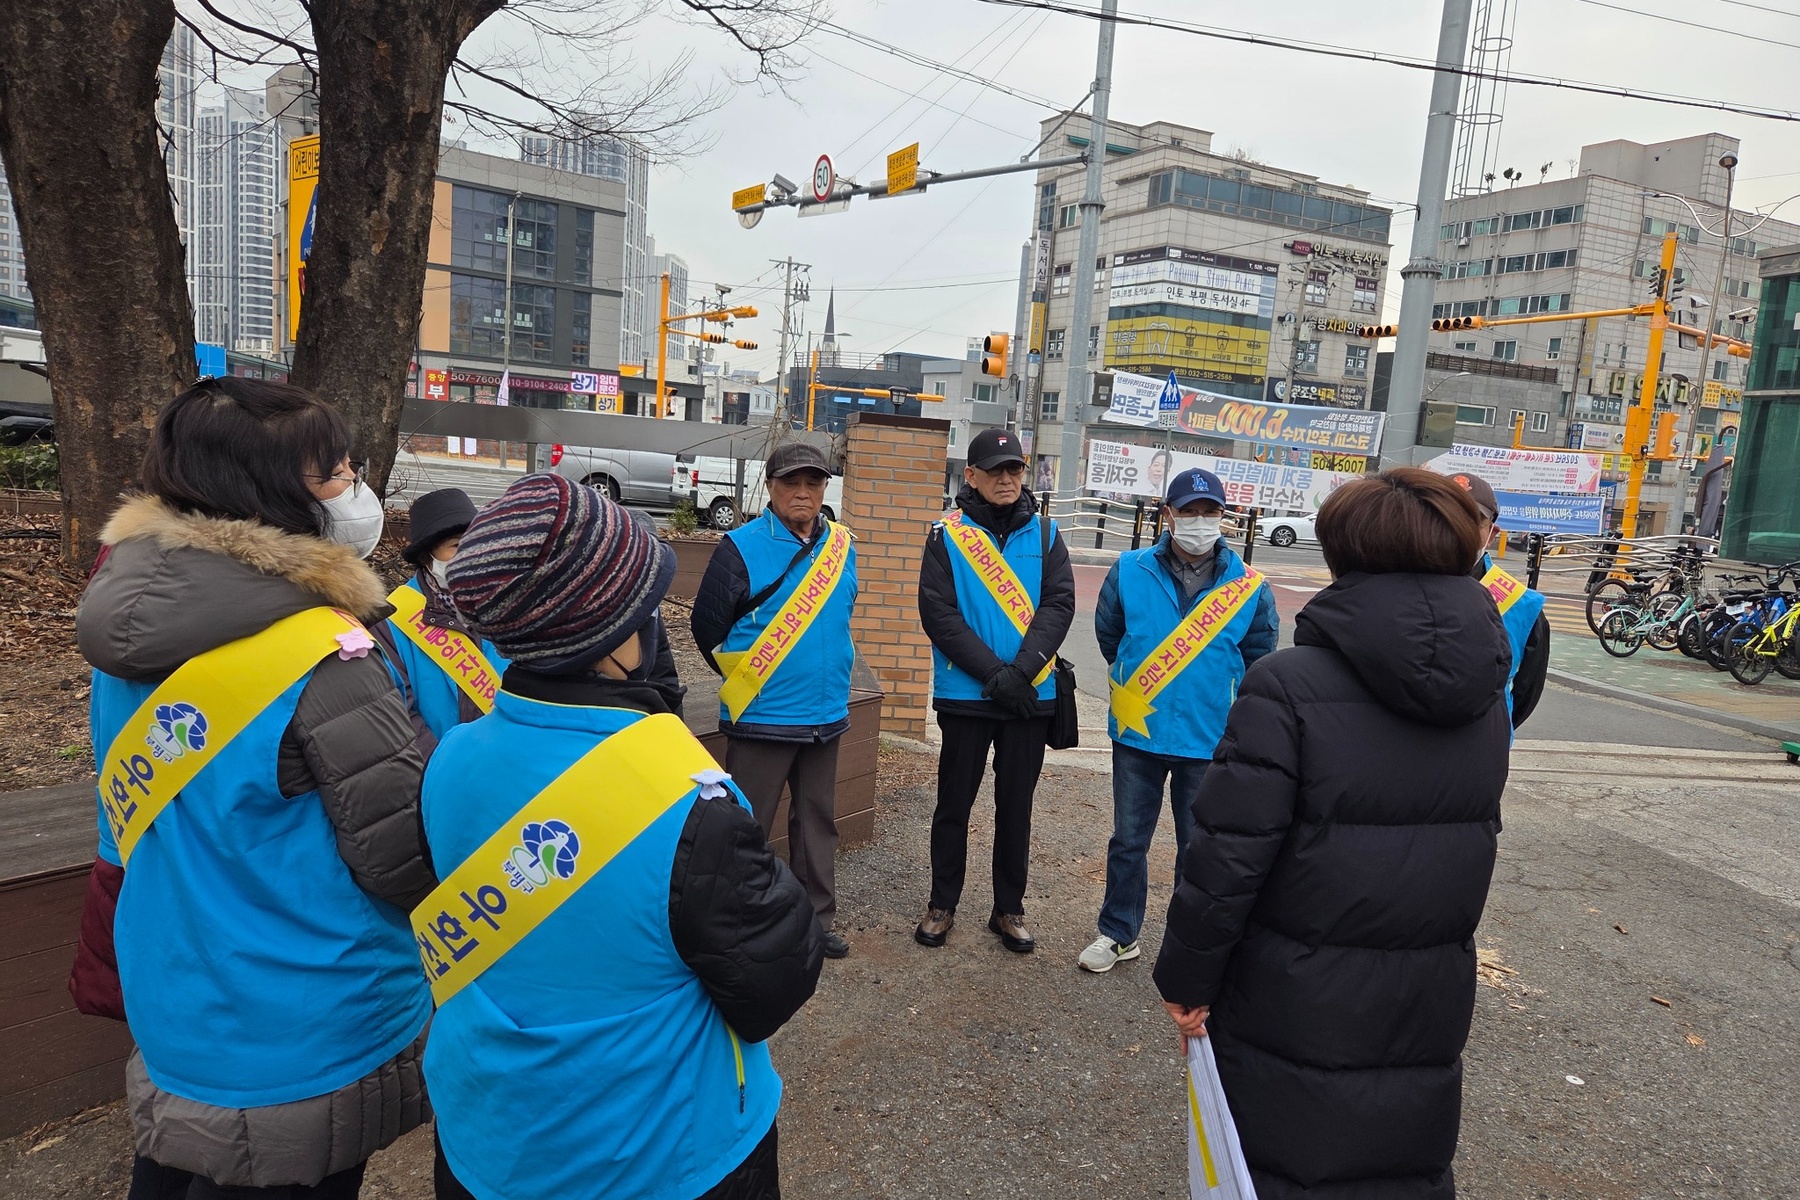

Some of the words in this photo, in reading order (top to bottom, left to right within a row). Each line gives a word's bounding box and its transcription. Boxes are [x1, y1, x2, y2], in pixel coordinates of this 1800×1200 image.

[816, 165, 829, 190] 50
[1037, 239, 1049, 282] 독서실
[1353, 250, 1383, 269] 독서실
[1206, 268, 1229, 289] STUDY
[1235, 273, 1255, 293] PLACE
[1166, 286, 1184, 300] 인토
[1189, 289, 1207, 305] 부평
[1211, 293, 1239, 309] 독서실
[428, 373, 446, 382] 중앙
[451, 373, 501, 385] 507-7600
[572, 373, 597, 392] 상가
[599, 374, 618, 386] 임대
[598, 398, 616, 411] 상가
[145, 735, 173, 765] 부평구
[501, 858, 535, 896] 부평구
